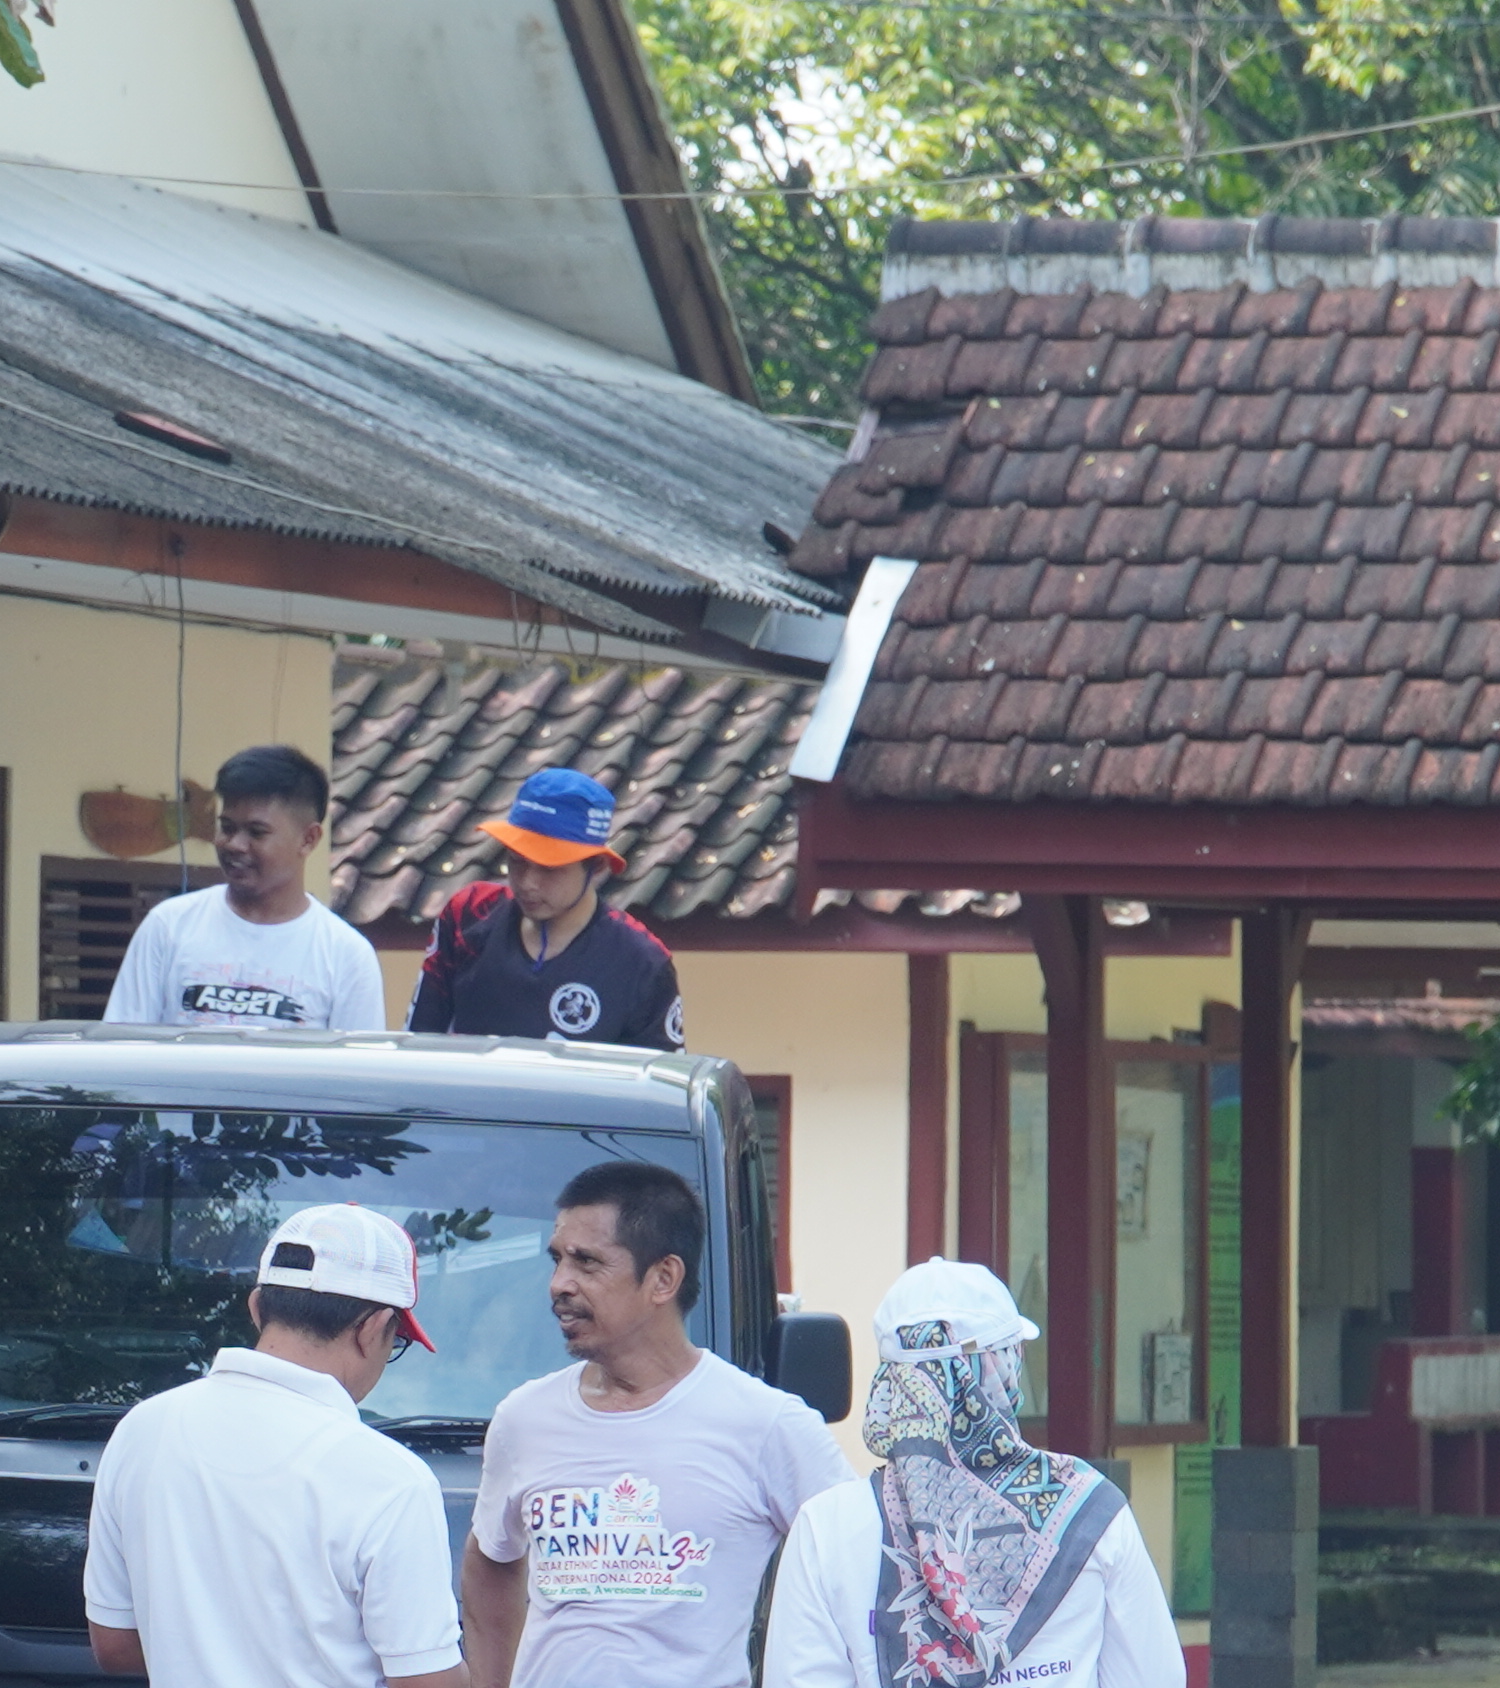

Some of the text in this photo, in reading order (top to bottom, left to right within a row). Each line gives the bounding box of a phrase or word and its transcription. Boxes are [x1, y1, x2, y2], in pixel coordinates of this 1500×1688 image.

[195, 985, 284, 1016] ASSET
[530, 1493, 600, 1531] BEN
[605, 1511, 659, 1523] carnival
[535, 1533, 669, 1558] CARNIVAL
[666, 1536, 711, 1571] 3rd
[564, 1560, 599, 1571] ETHNIC
[602, 1559, 663, 1571] NATIONAL
[554, 1573, 633, 1585] INTERNATIONAL
[633, 1572, 675, 1585] 2024
[594, 1585, 648, 1596] Awesome
[649, 1585, 703, 1598] Indonesia
[1016, 1660, 1072, 1683] NEGERI
